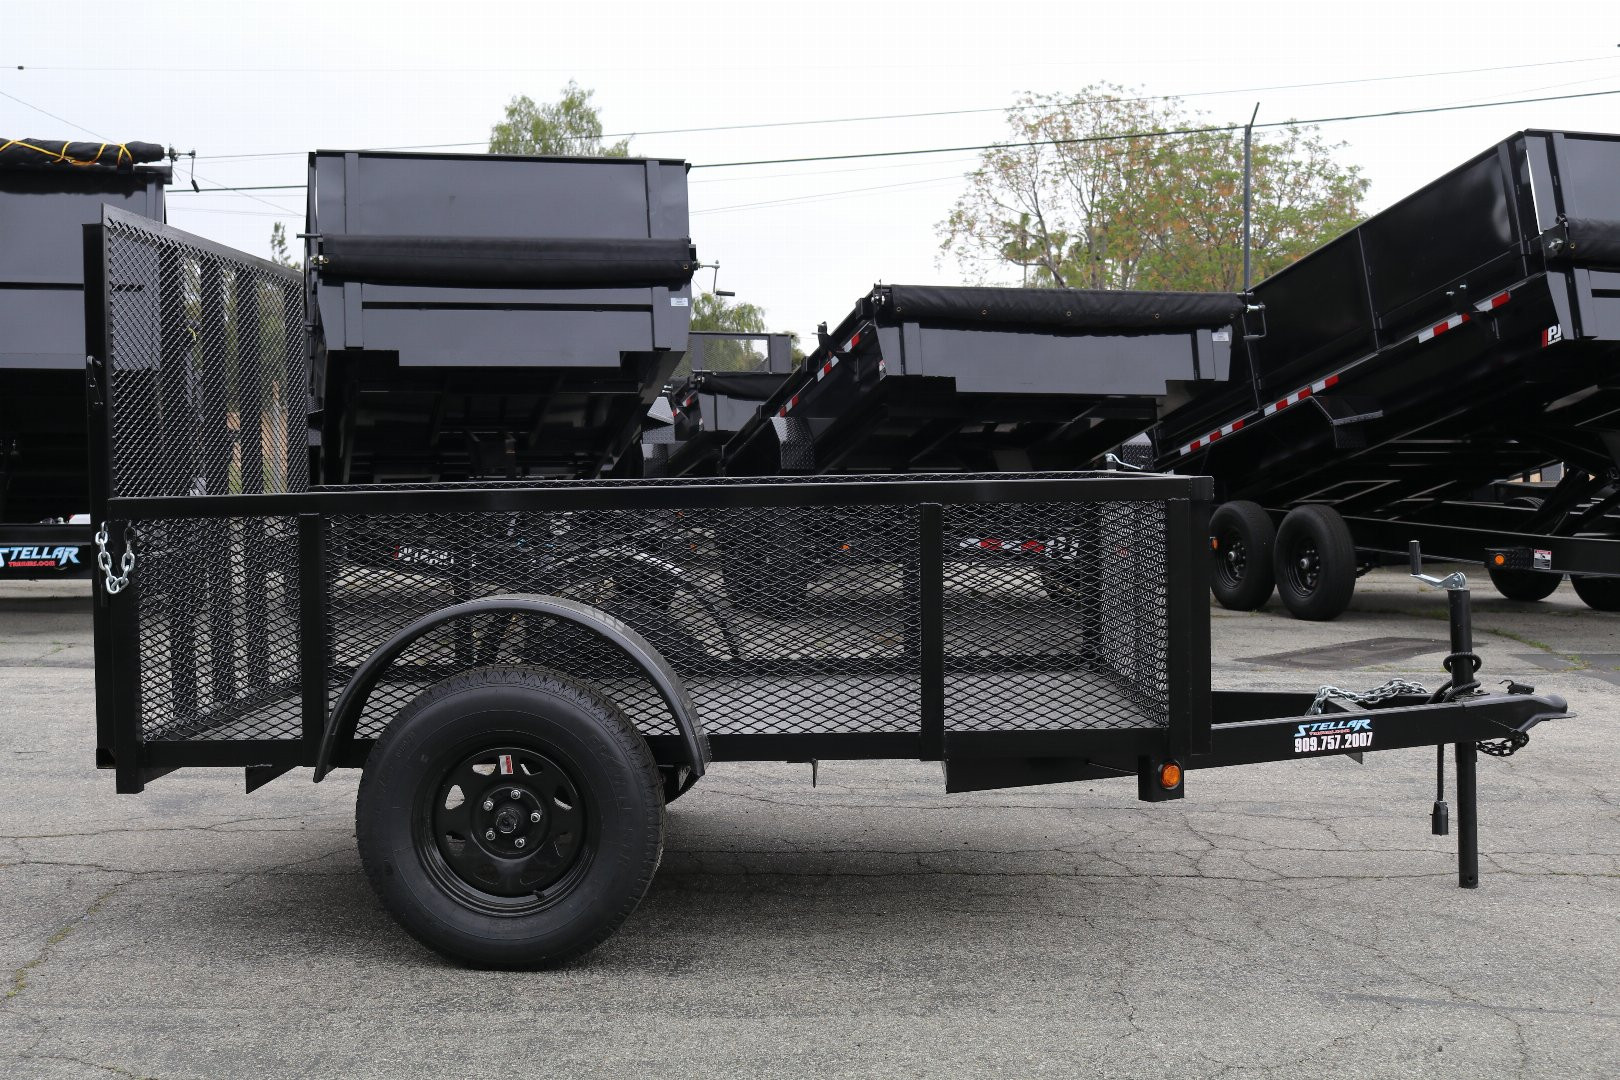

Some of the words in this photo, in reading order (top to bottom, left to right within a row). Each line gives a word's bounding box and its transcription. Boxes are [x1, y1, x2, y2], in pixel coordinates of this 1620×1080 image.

[1548, 323, 1561, 341] PJ
[1294, 719, 1373, 738] STELLAR
[1295, 731, 1373, 752] 909.757.2007
